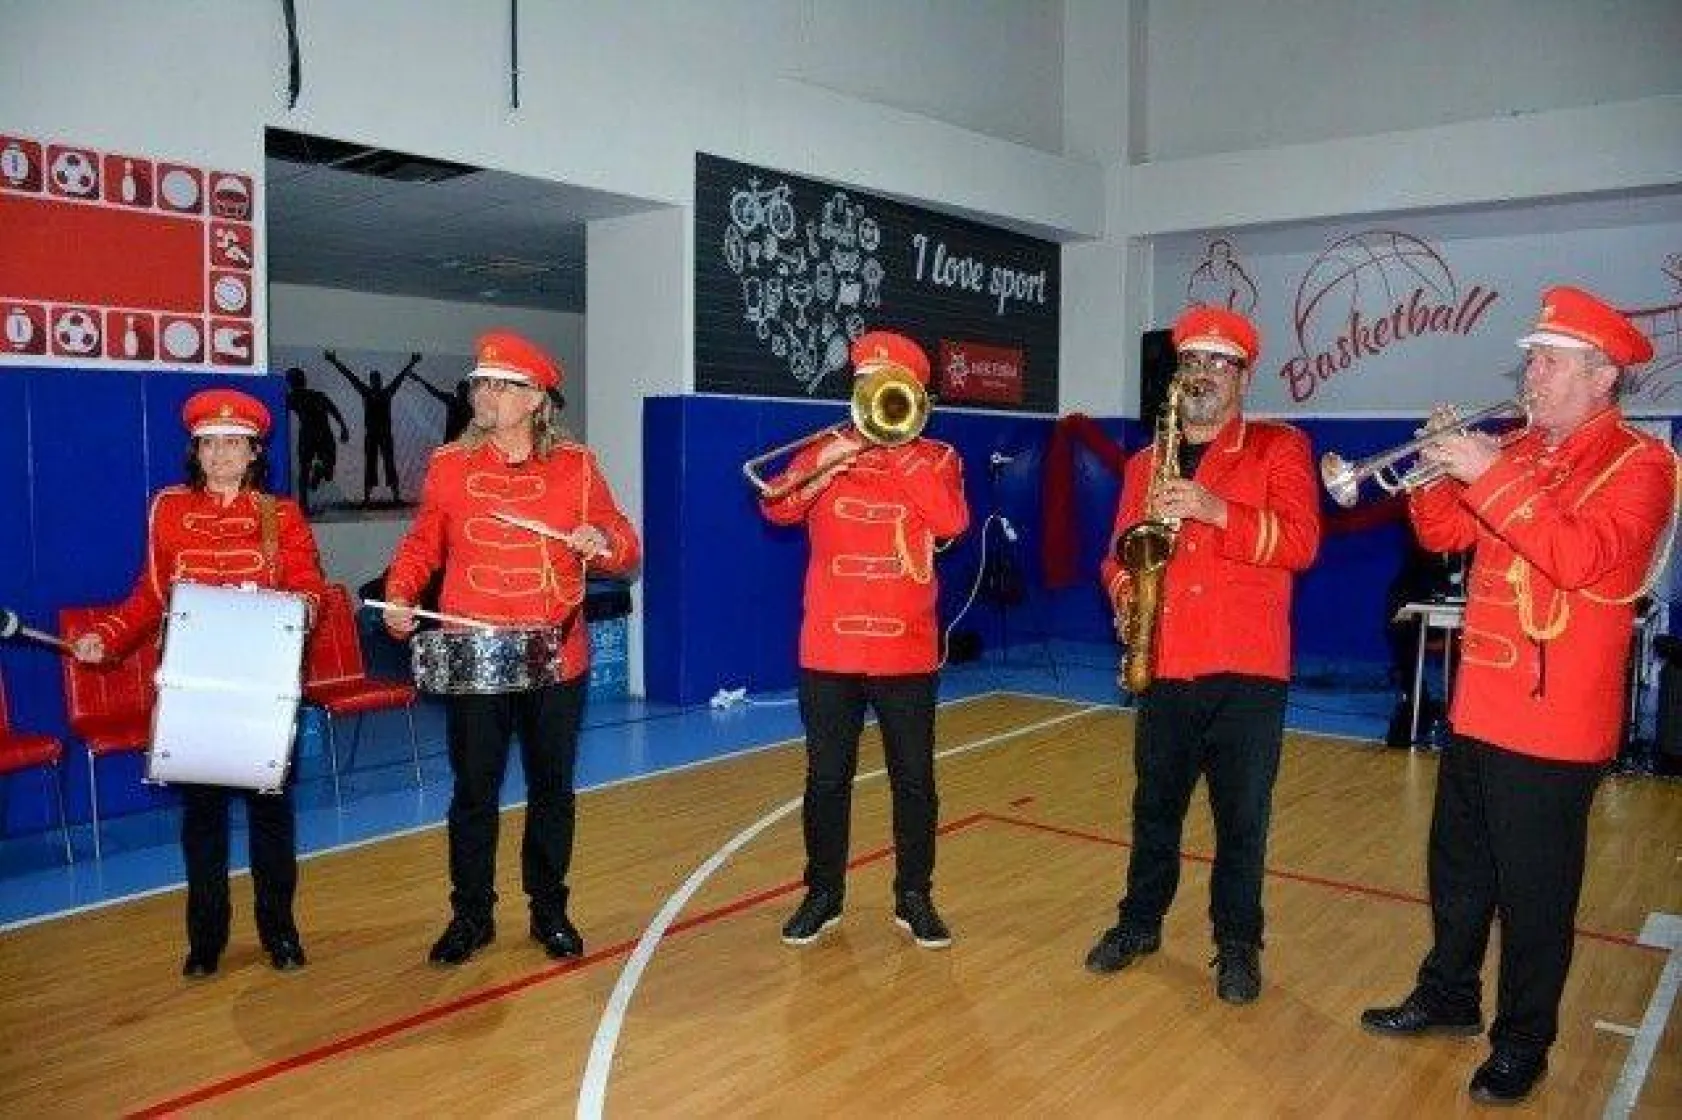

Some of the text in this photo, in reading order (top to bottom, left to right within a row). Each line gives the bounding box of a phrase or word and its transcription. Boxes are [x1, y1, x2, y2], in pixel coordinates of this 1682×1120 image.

[913, 233, 1047, 315] I love sport
[1279, 286, 1498, 402] Basketball
